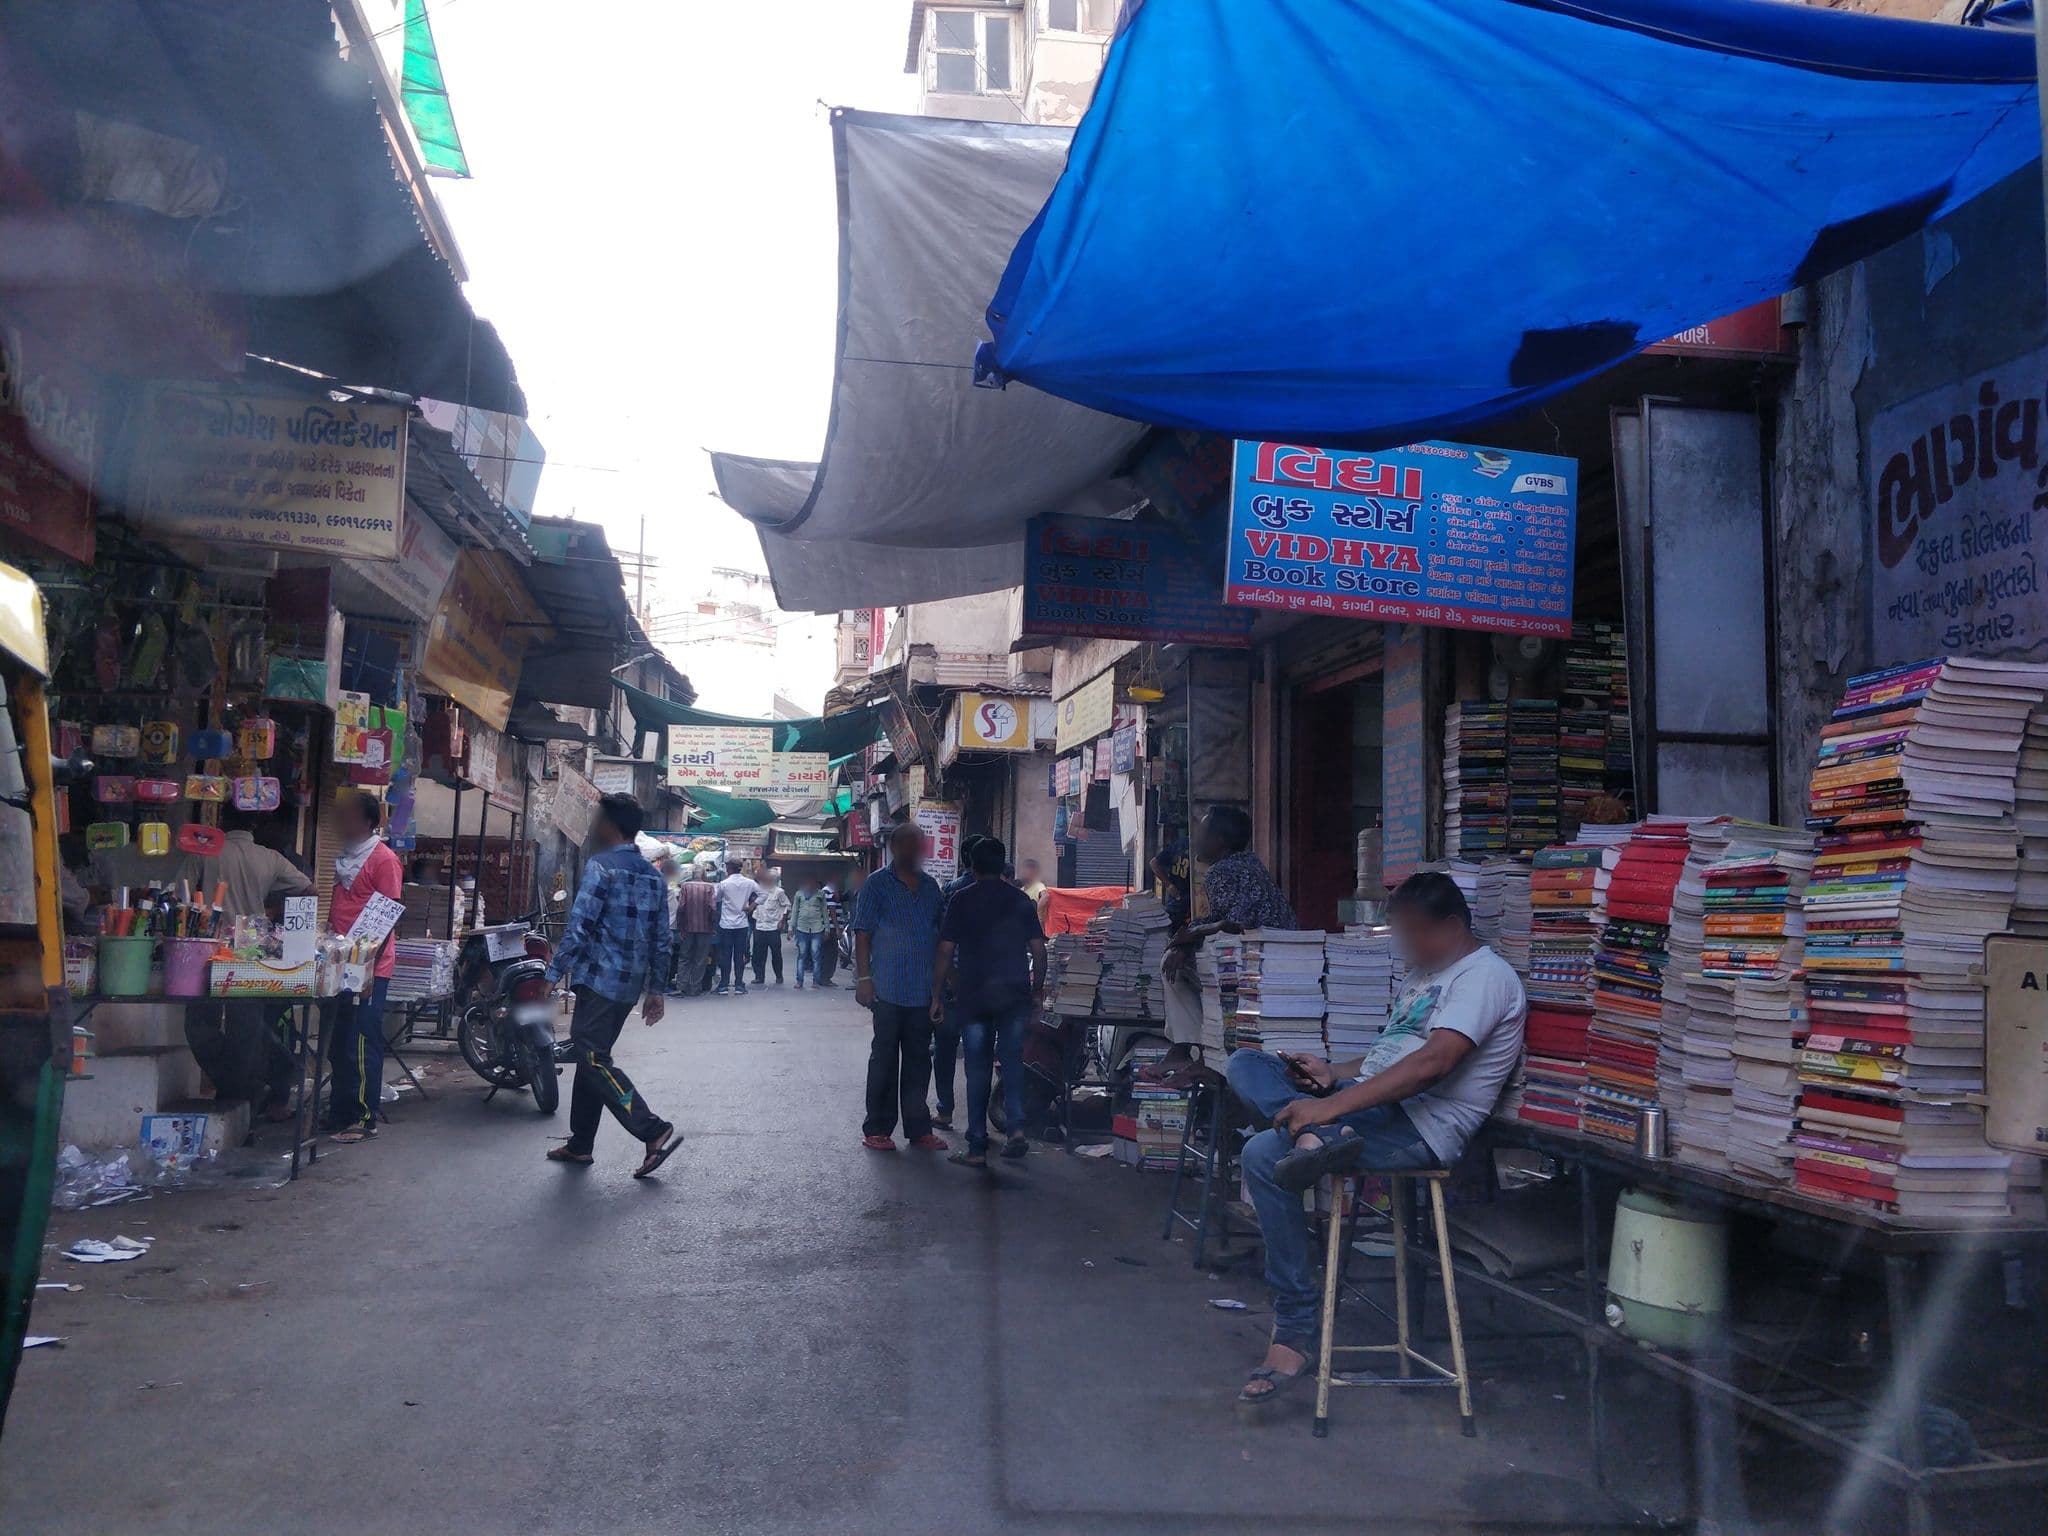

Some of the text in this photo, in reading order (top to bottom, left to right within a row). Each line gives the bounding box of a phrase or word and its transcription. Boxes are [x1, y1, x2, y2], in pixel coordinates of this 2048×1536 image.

[1525, 476, 1554, 488] GVBS
[1251, 495, 1420, 534] બુક સ્ટોર્સ
[1245, 529, 1422, 573] VIDHYA
[1243, 561, 1420, 597] Book Store
[1037, 584, 1148, 608] VIDHYA
[1289, 595, 1306, 608] પુલ
[1310, 595, 1335, 610] નીચે,
[1342, 600, 1374, 612] કાગદી
[1379, 606, 1410, 618] બજાર,
[1416, 606, 1440, 620] ગાંધી
[1037, 604, 1088, 619] Book
[671, 750, 715, 765] ડાયરી
[788, 769, 827, 781] ડાયરી
